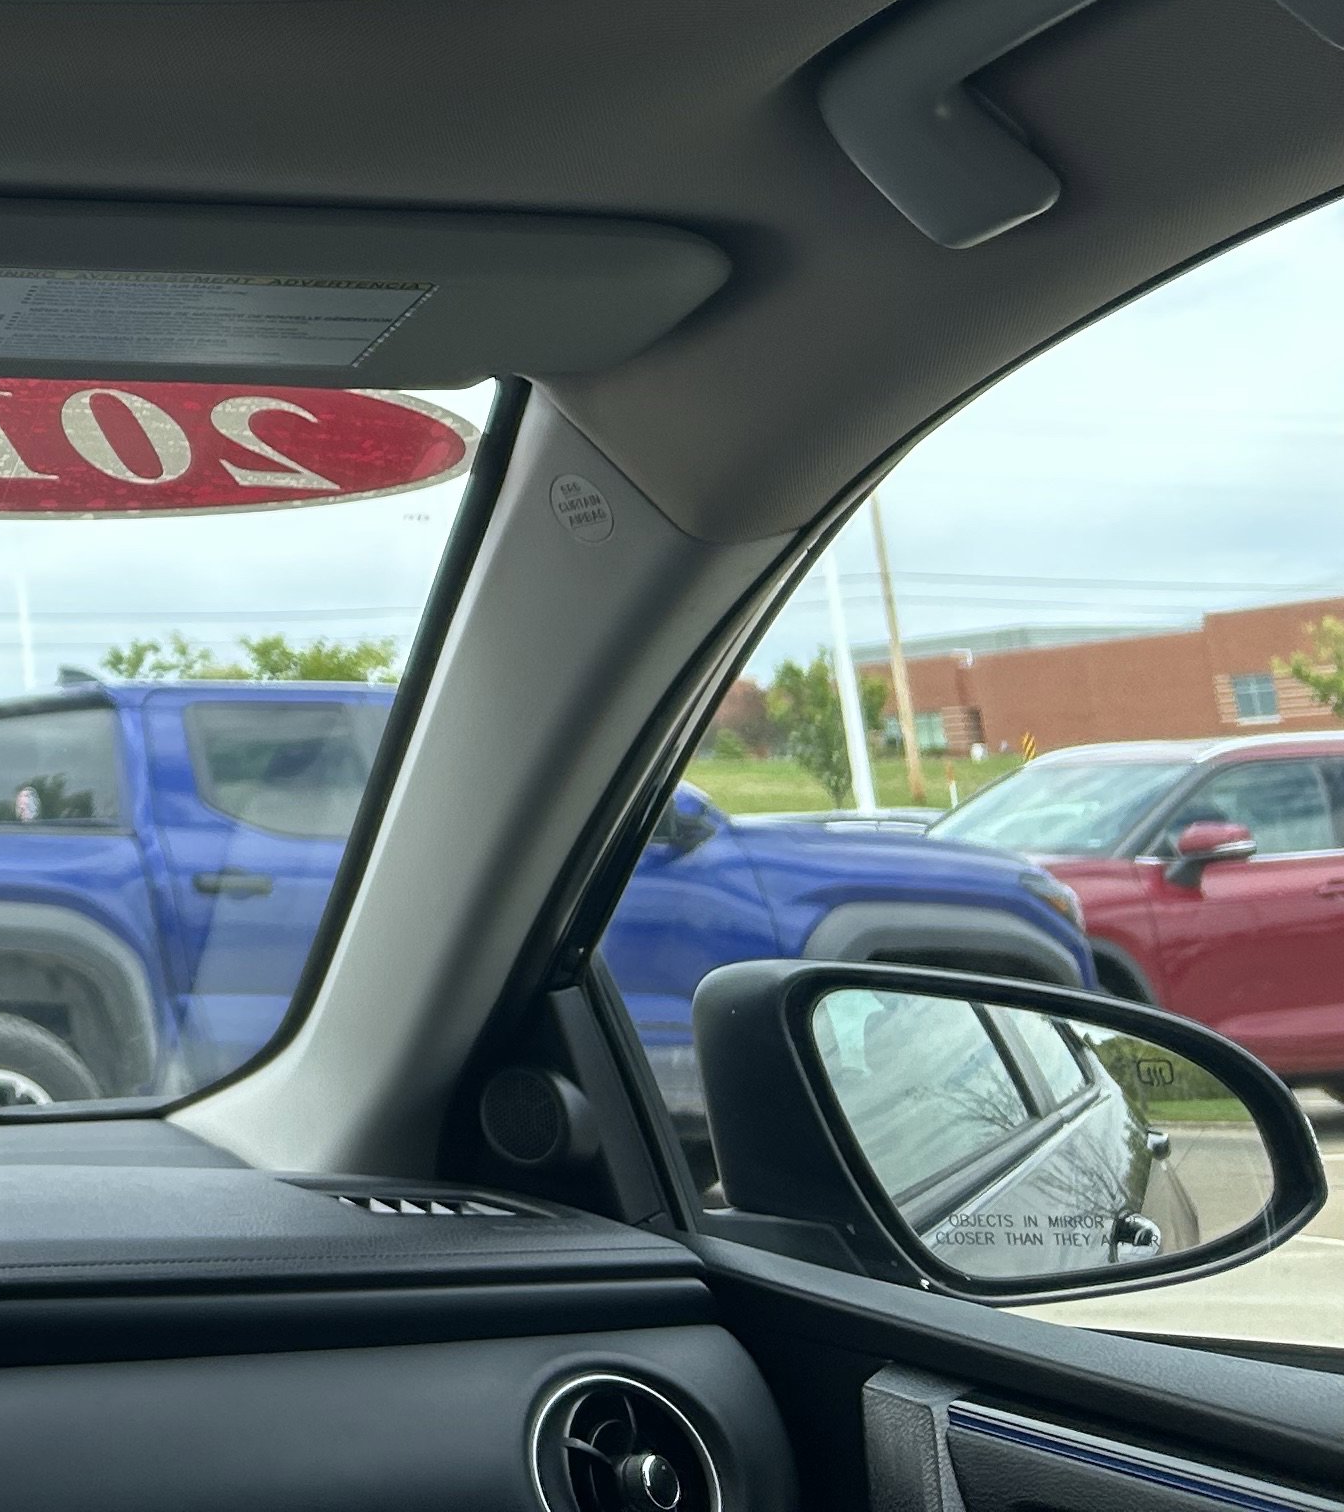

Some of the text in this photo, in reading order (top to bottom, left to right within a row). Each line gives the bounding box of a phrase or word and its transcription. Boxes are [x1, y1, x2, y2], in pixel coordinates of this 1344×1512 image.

[268, 278, 422, 290] ADVERTENCIA
[949, 1213, 1014, 1229] OBJECTS
[1023, 1214, 1039, 1228] IN
[1047, 1214, 1106, 1229] MIRROR
[936, 1231, 996, 1246] CLOSER
[1005, 1232, 1044, 1246] THAN
[1052, 1233, 1091, 1247] THEY
